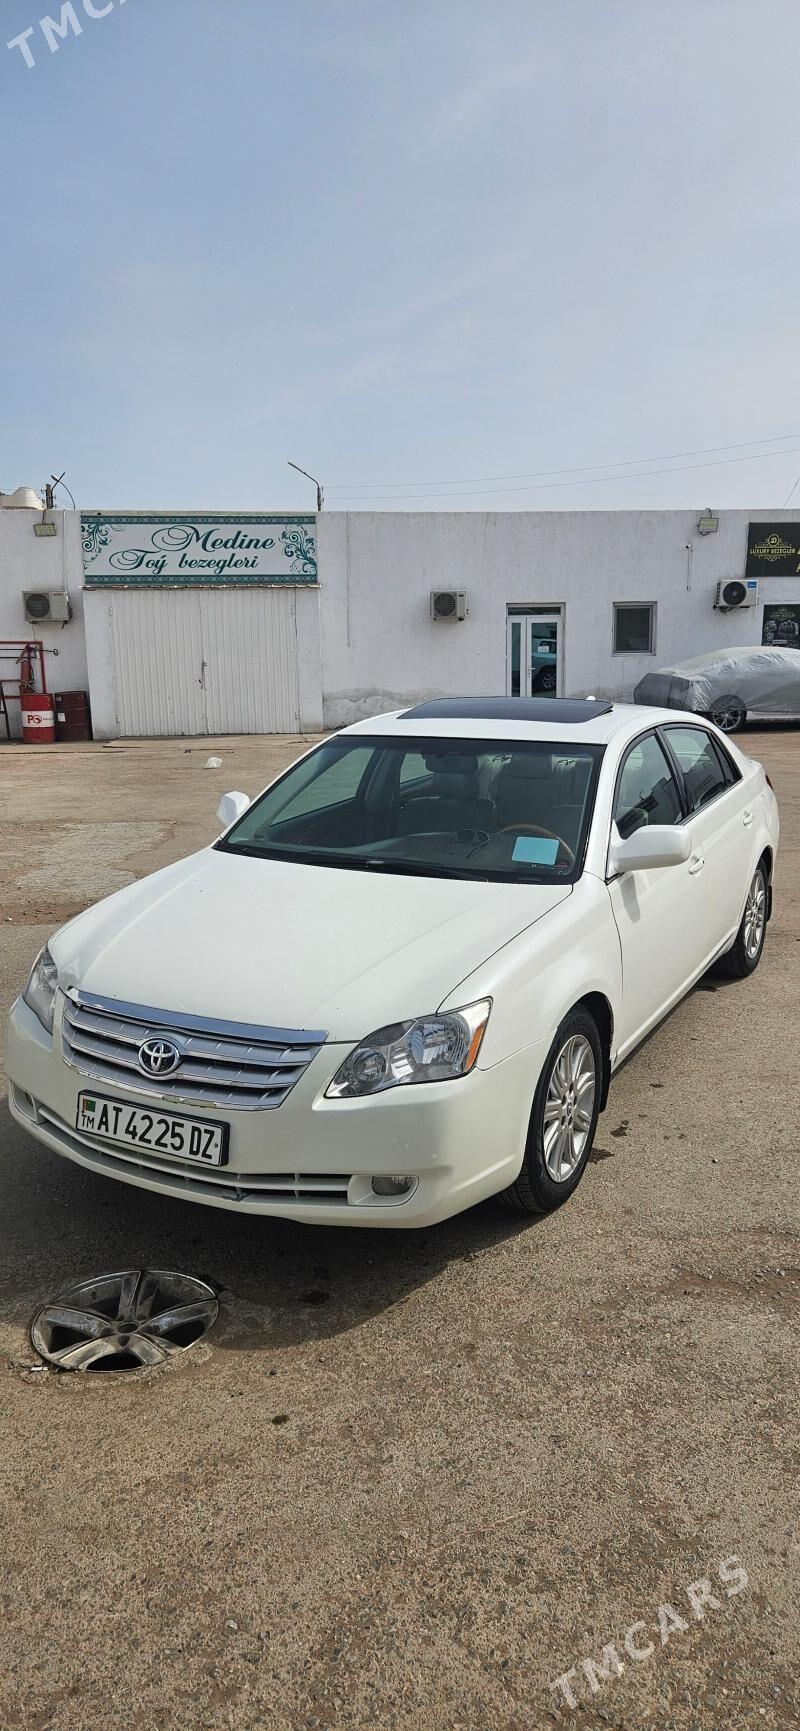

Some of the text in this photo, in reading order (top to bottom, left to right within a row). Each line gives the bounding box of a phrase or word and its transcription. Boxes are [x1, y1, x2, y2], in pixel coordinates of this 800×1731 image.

[151, 525, 275, 553] Medine
[109, 549, 259, 574] Toý bezegleri
[81, 1114, 95, 1129] TM
